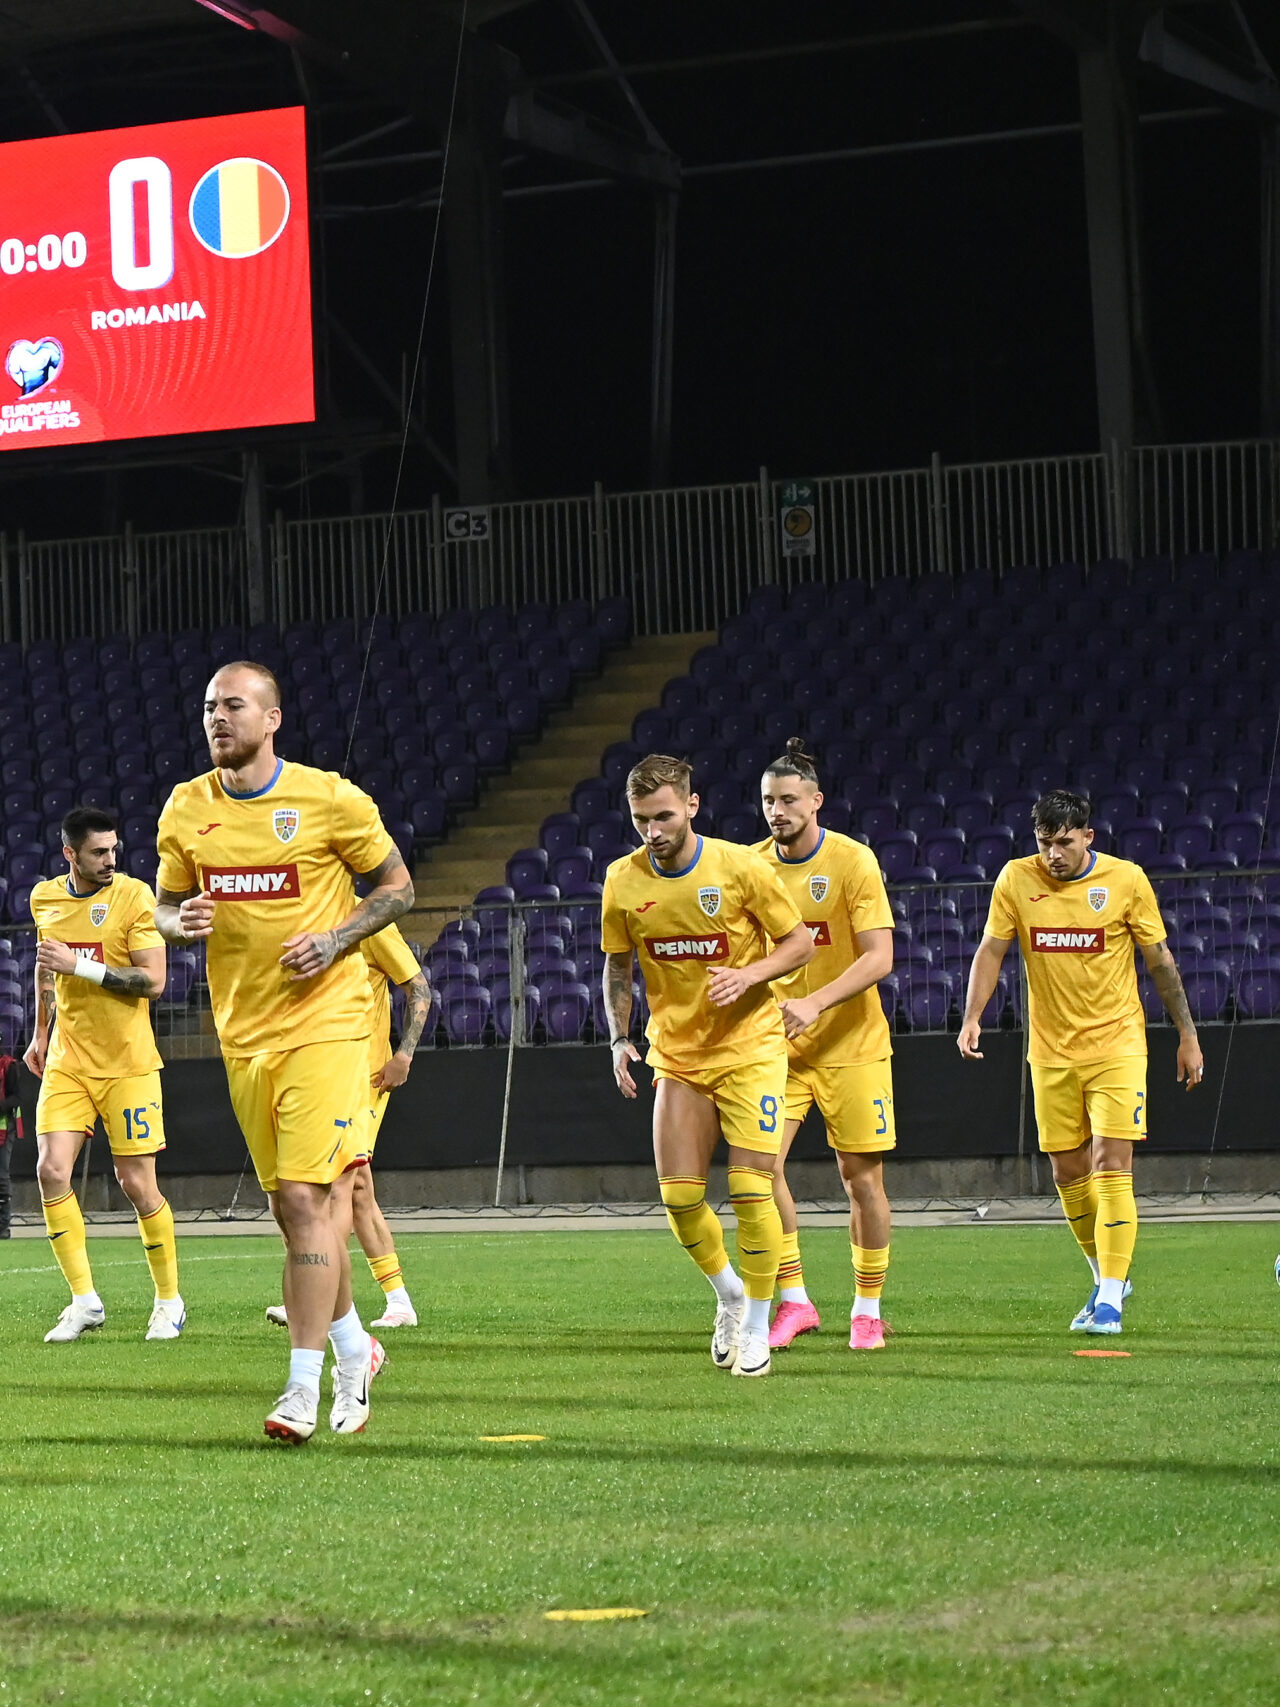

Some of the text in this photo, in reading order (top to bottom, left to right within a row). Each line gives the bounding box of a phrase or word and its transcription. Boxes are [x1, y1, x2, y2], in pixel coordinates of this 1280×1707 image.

[108, 156, 175, 292] 0
[90, 300, 206, 331] ROMANIA
[1, 400, 72, 420] EUROPEAN
[447, 512, 488, 538] C3
[122, 1107, 150, 1140] 15
[759, 1095, 778, 1133] 9
[873, 1099, 887, 1135] 3
